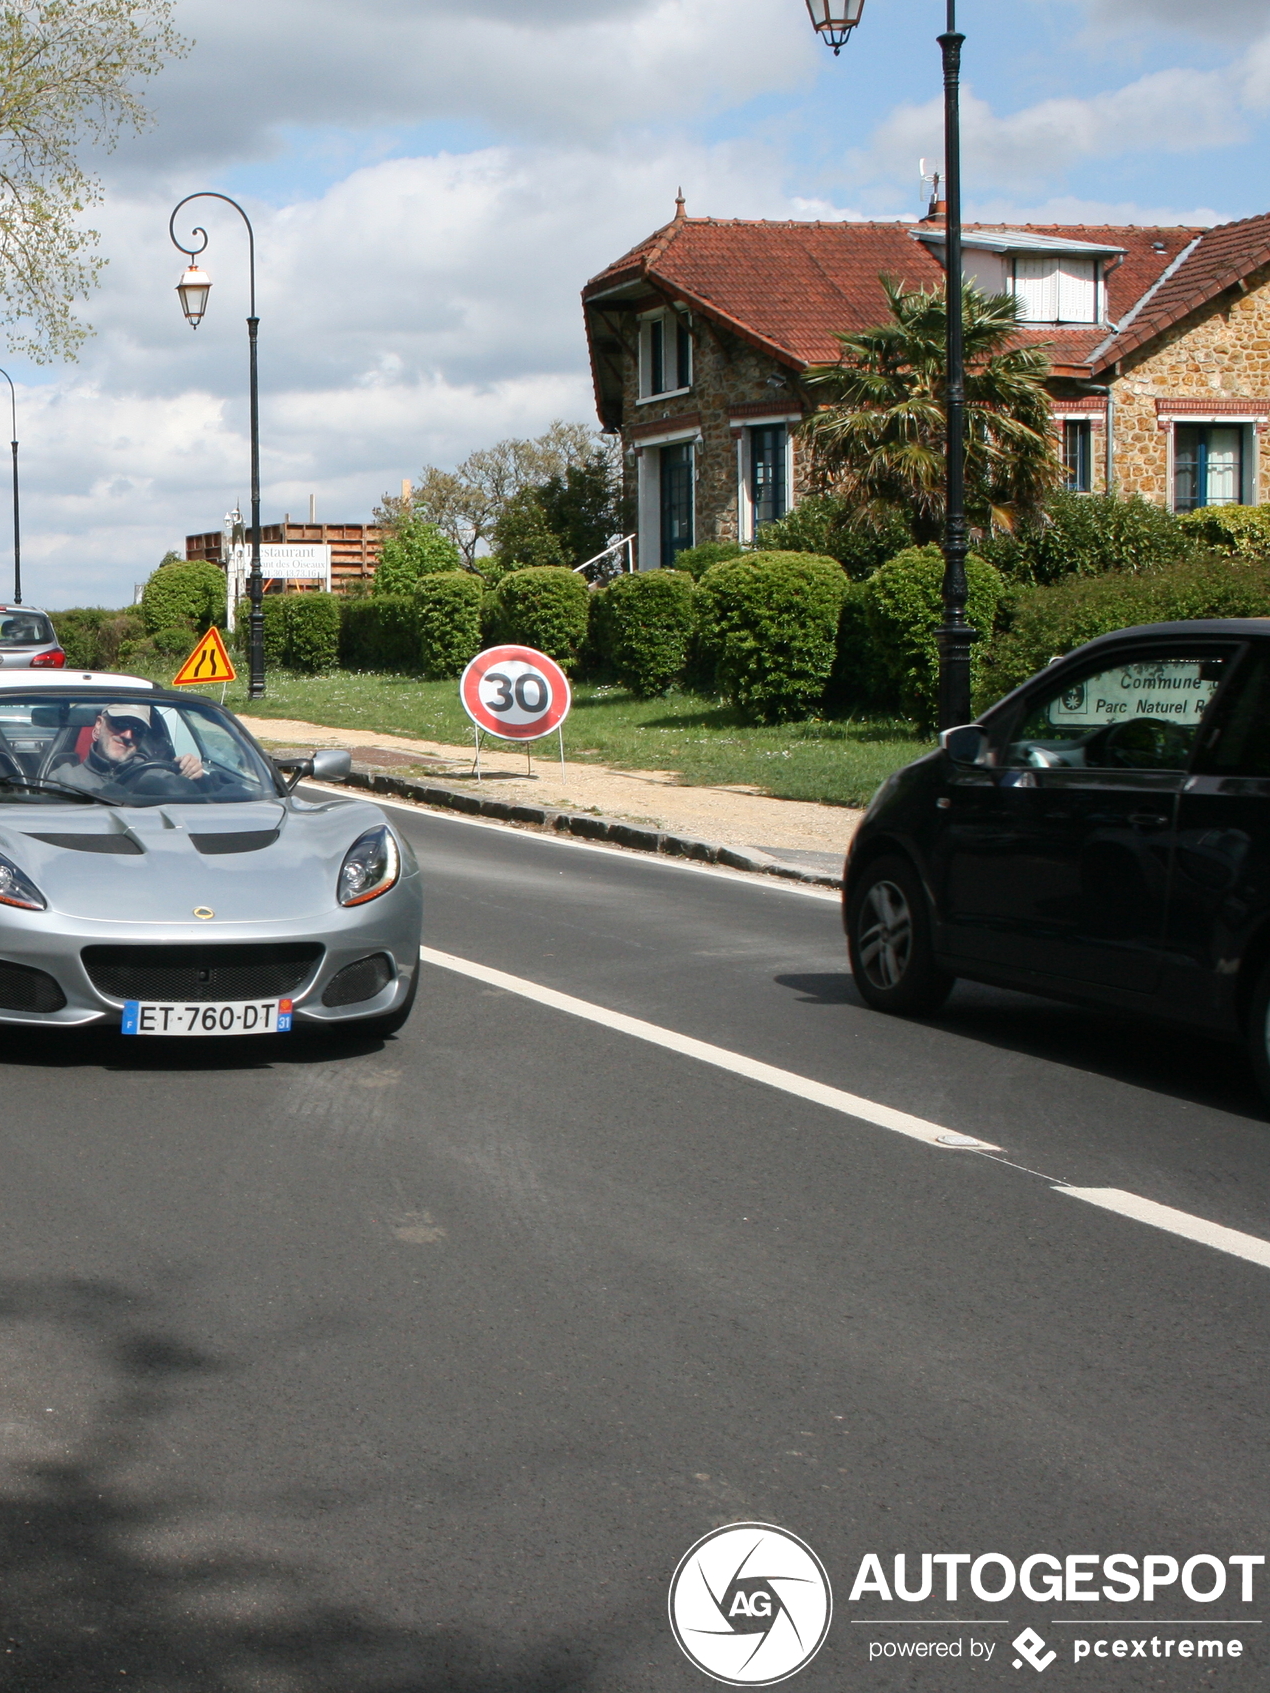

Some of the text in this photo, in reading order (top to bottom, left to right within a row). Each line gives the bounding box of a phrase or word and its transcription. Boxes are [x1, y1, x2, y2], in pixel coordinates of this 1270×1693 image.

[276, 560, 290, 568] des
[292, 560, 325, 568] Oiseaux
[1120, 674, 1202, 690] Commune
[484, 672, 548, 713] 30
[1096, 699, 1127, 713] Parc
[1136, 699, 1187, 714] Naturel
[139, 1003, 275, 1031] ET-760-DT
[278, 1017, 290, 1029] 31
